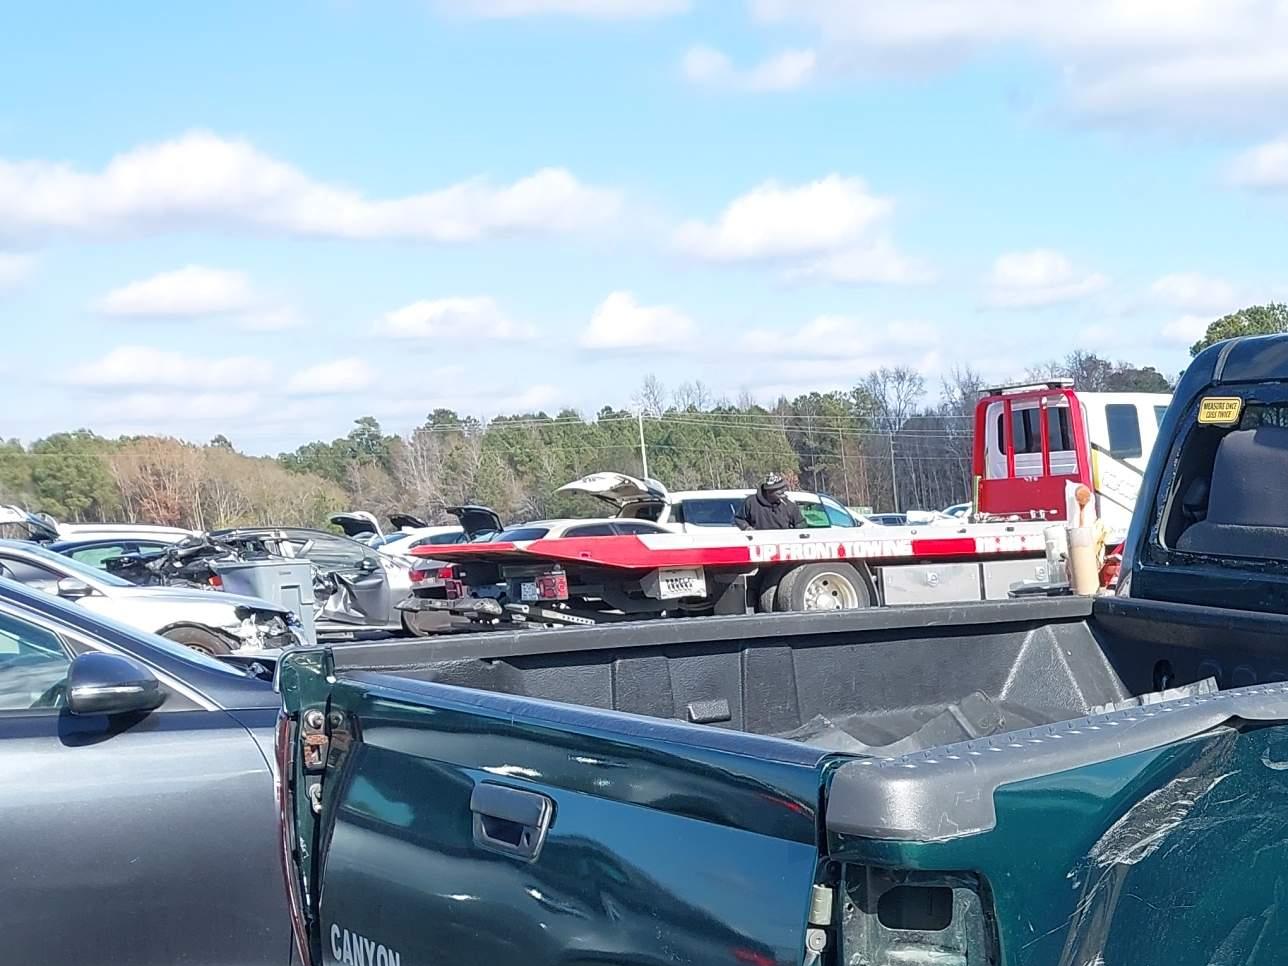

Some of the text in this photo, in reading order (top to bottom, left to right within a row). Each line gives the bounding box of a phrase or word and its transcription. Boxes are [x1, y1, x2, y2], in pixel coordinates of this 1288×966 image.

[1203, 402, 1238, 410] MEASURE ONCE
[749, 544, 777, 562] UP
[779, 542, 840, 561] FRONT
